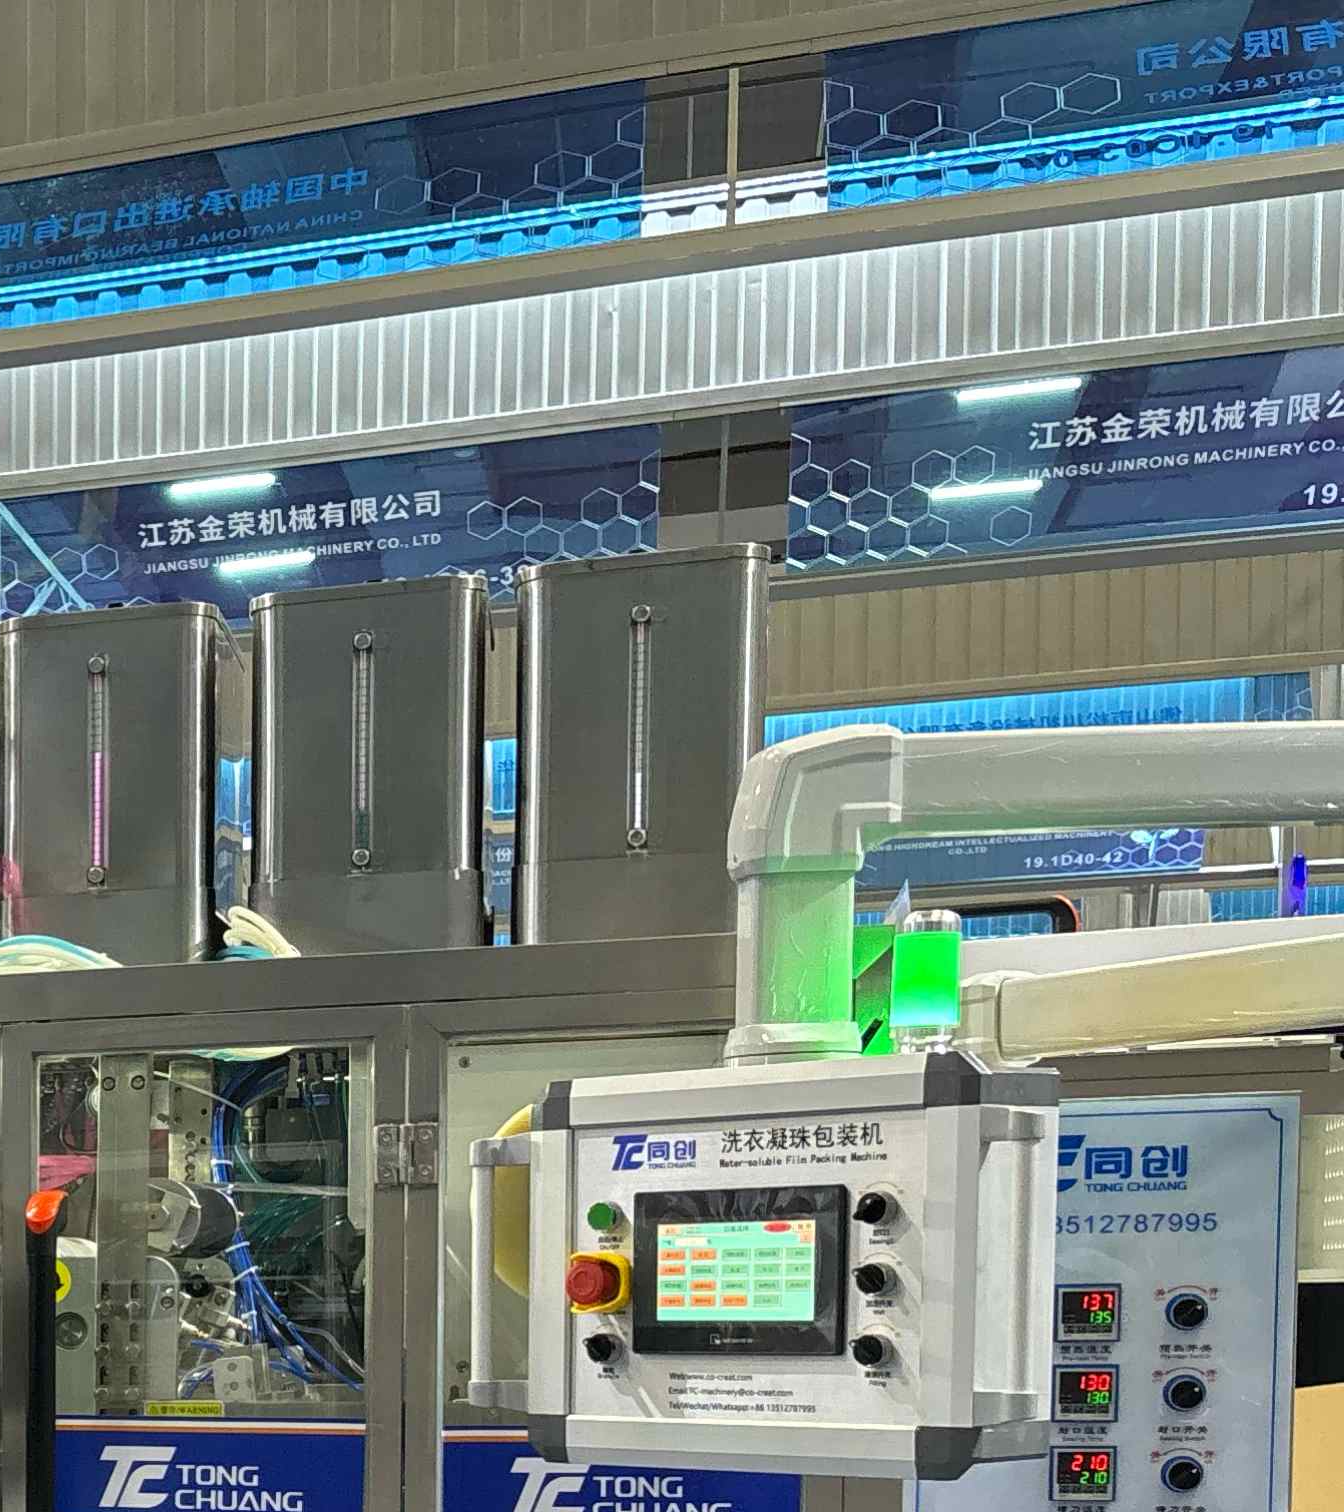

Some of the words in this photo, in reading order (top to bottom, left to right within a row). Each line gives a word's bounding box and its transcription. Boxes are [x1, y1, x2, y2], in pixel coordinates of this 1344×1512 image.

[1026, 462, 1103, 481] JIANGSU
[1107, 454, 1189, 474] JINRONG
[1194, 442, 1304, 465] MACHINERY
[137, 489, 442, 549] 江苏金荣机械有限公司
[143, 557, 209, 576] JIANGSU
[280, 540, 373, 564] MACHINERY
[378, 536, 415, 551] CO.,
[419, 532, 441, 547] LTD
[1023, 851, 1123, 869] 19.1D40-42
[721, 1122, 883, 1153] 洗衣凝珠包装机
[647, 1139, 696, 1161] 同创
[720, 1156, 782, 1168] Water-soluble
[786, 1154, 807, 1165] Film
[811, 1153, 847, 1165] Packing
[851, 1151, 888, 1162] Machine
[1084, 1145, 1188, 1180] 同创
[1085, 1183, 1123, 1192] TONG
[1127, 1181, 1187, 1191] CHUANG
[1082, 1293, 1113, 1311] 137
[1090, 1311, 1112, 1324] 135
[1080, 1375, 1110, 1391] 130
[1087, 1392, 1109, 1404] 130
[1072, 1455, 1108, 1471] 210
[175, 1464, 260, 1488] TONG
[1080, 1472, 1108, 1484] 210
[593, 1475, 684, 1499] TONG
